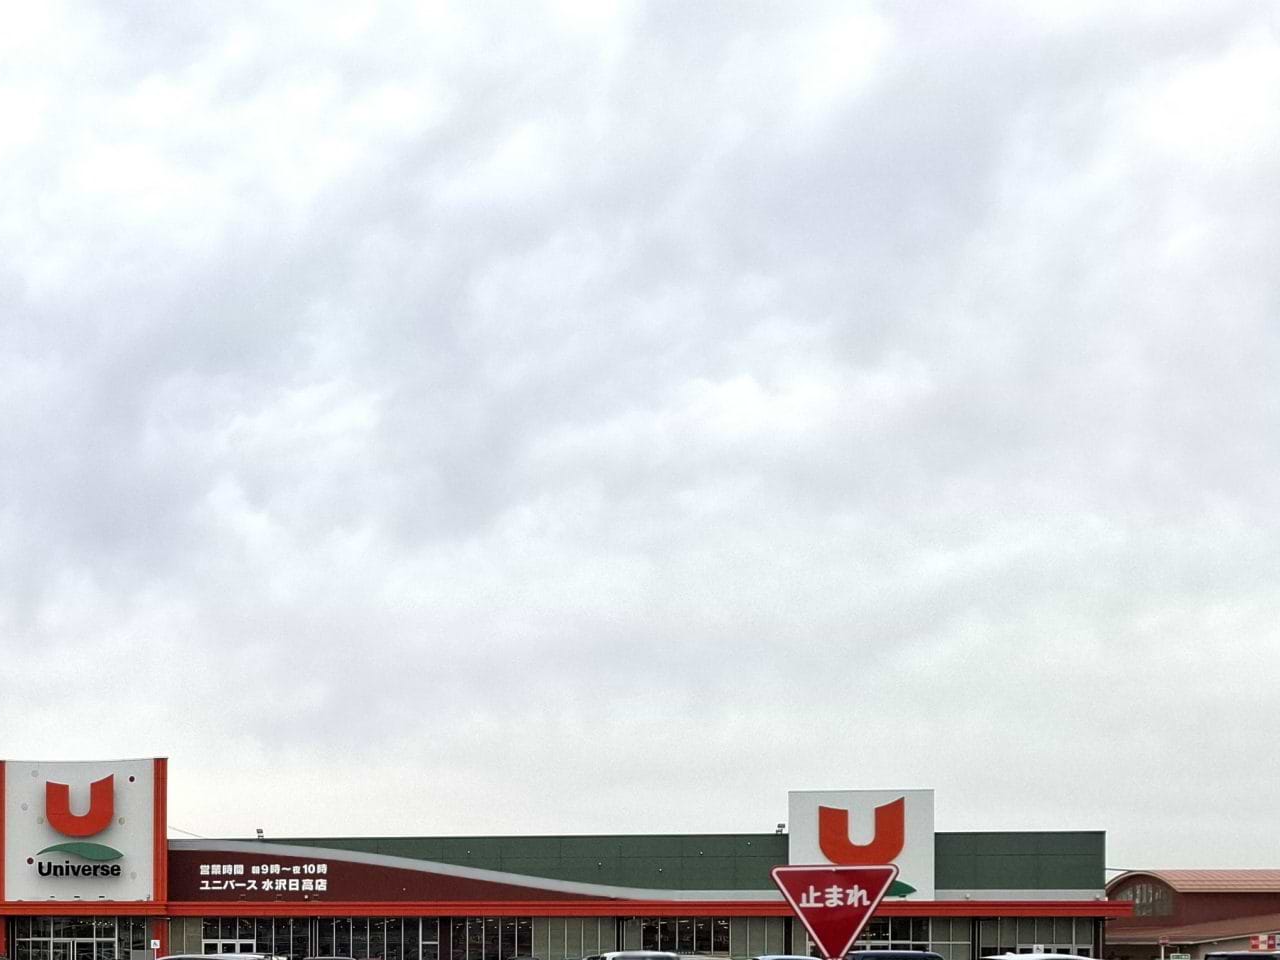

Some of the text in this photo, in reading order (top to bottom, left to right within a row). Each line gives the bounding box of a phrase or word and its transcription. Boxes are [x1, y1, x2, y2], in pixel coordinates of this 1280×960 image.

[45, 773, 114, 838] U
[37, 860, 122, 877] Universe
[199, 879, 328, 891] ユニバース 水沢日高店
[799, 884, 871, 908] 止まれ
